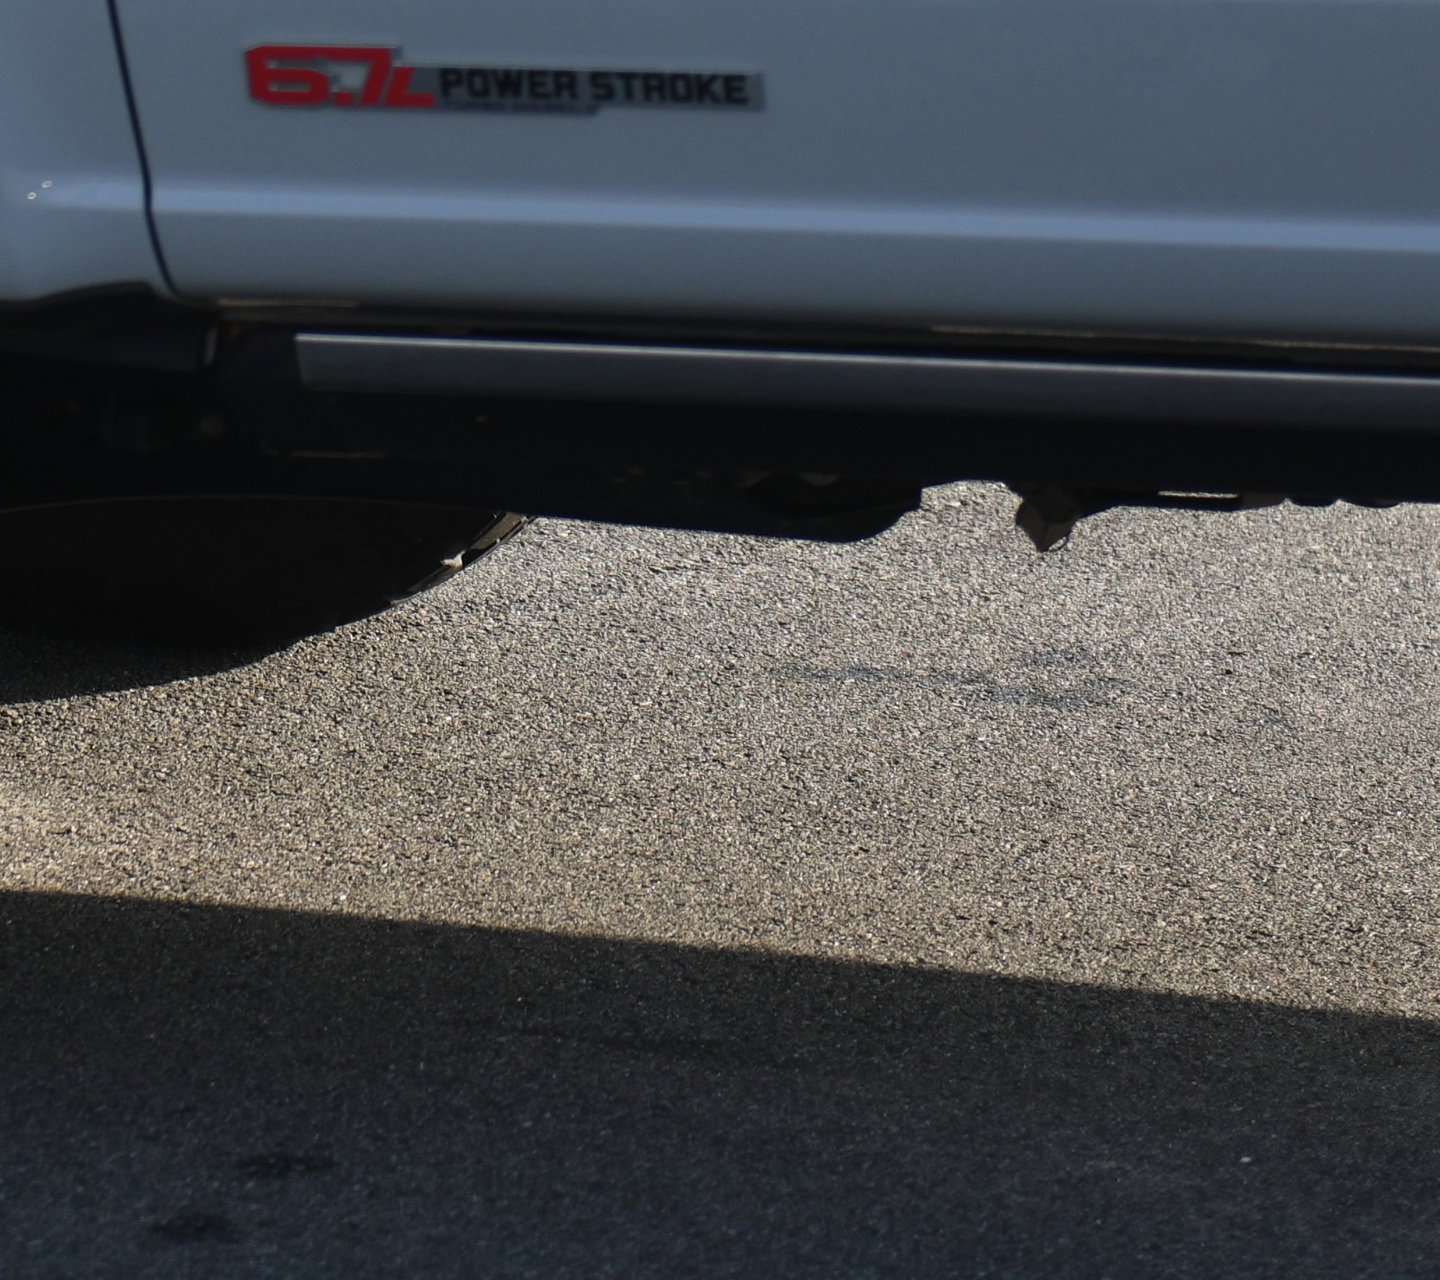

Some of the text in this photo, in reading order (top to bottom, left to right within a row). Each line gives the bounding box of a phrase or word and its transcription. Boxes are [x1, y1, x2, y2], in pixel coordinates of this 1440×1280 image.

[246, 45, 749, 107] 6.7L POWER STROKE
